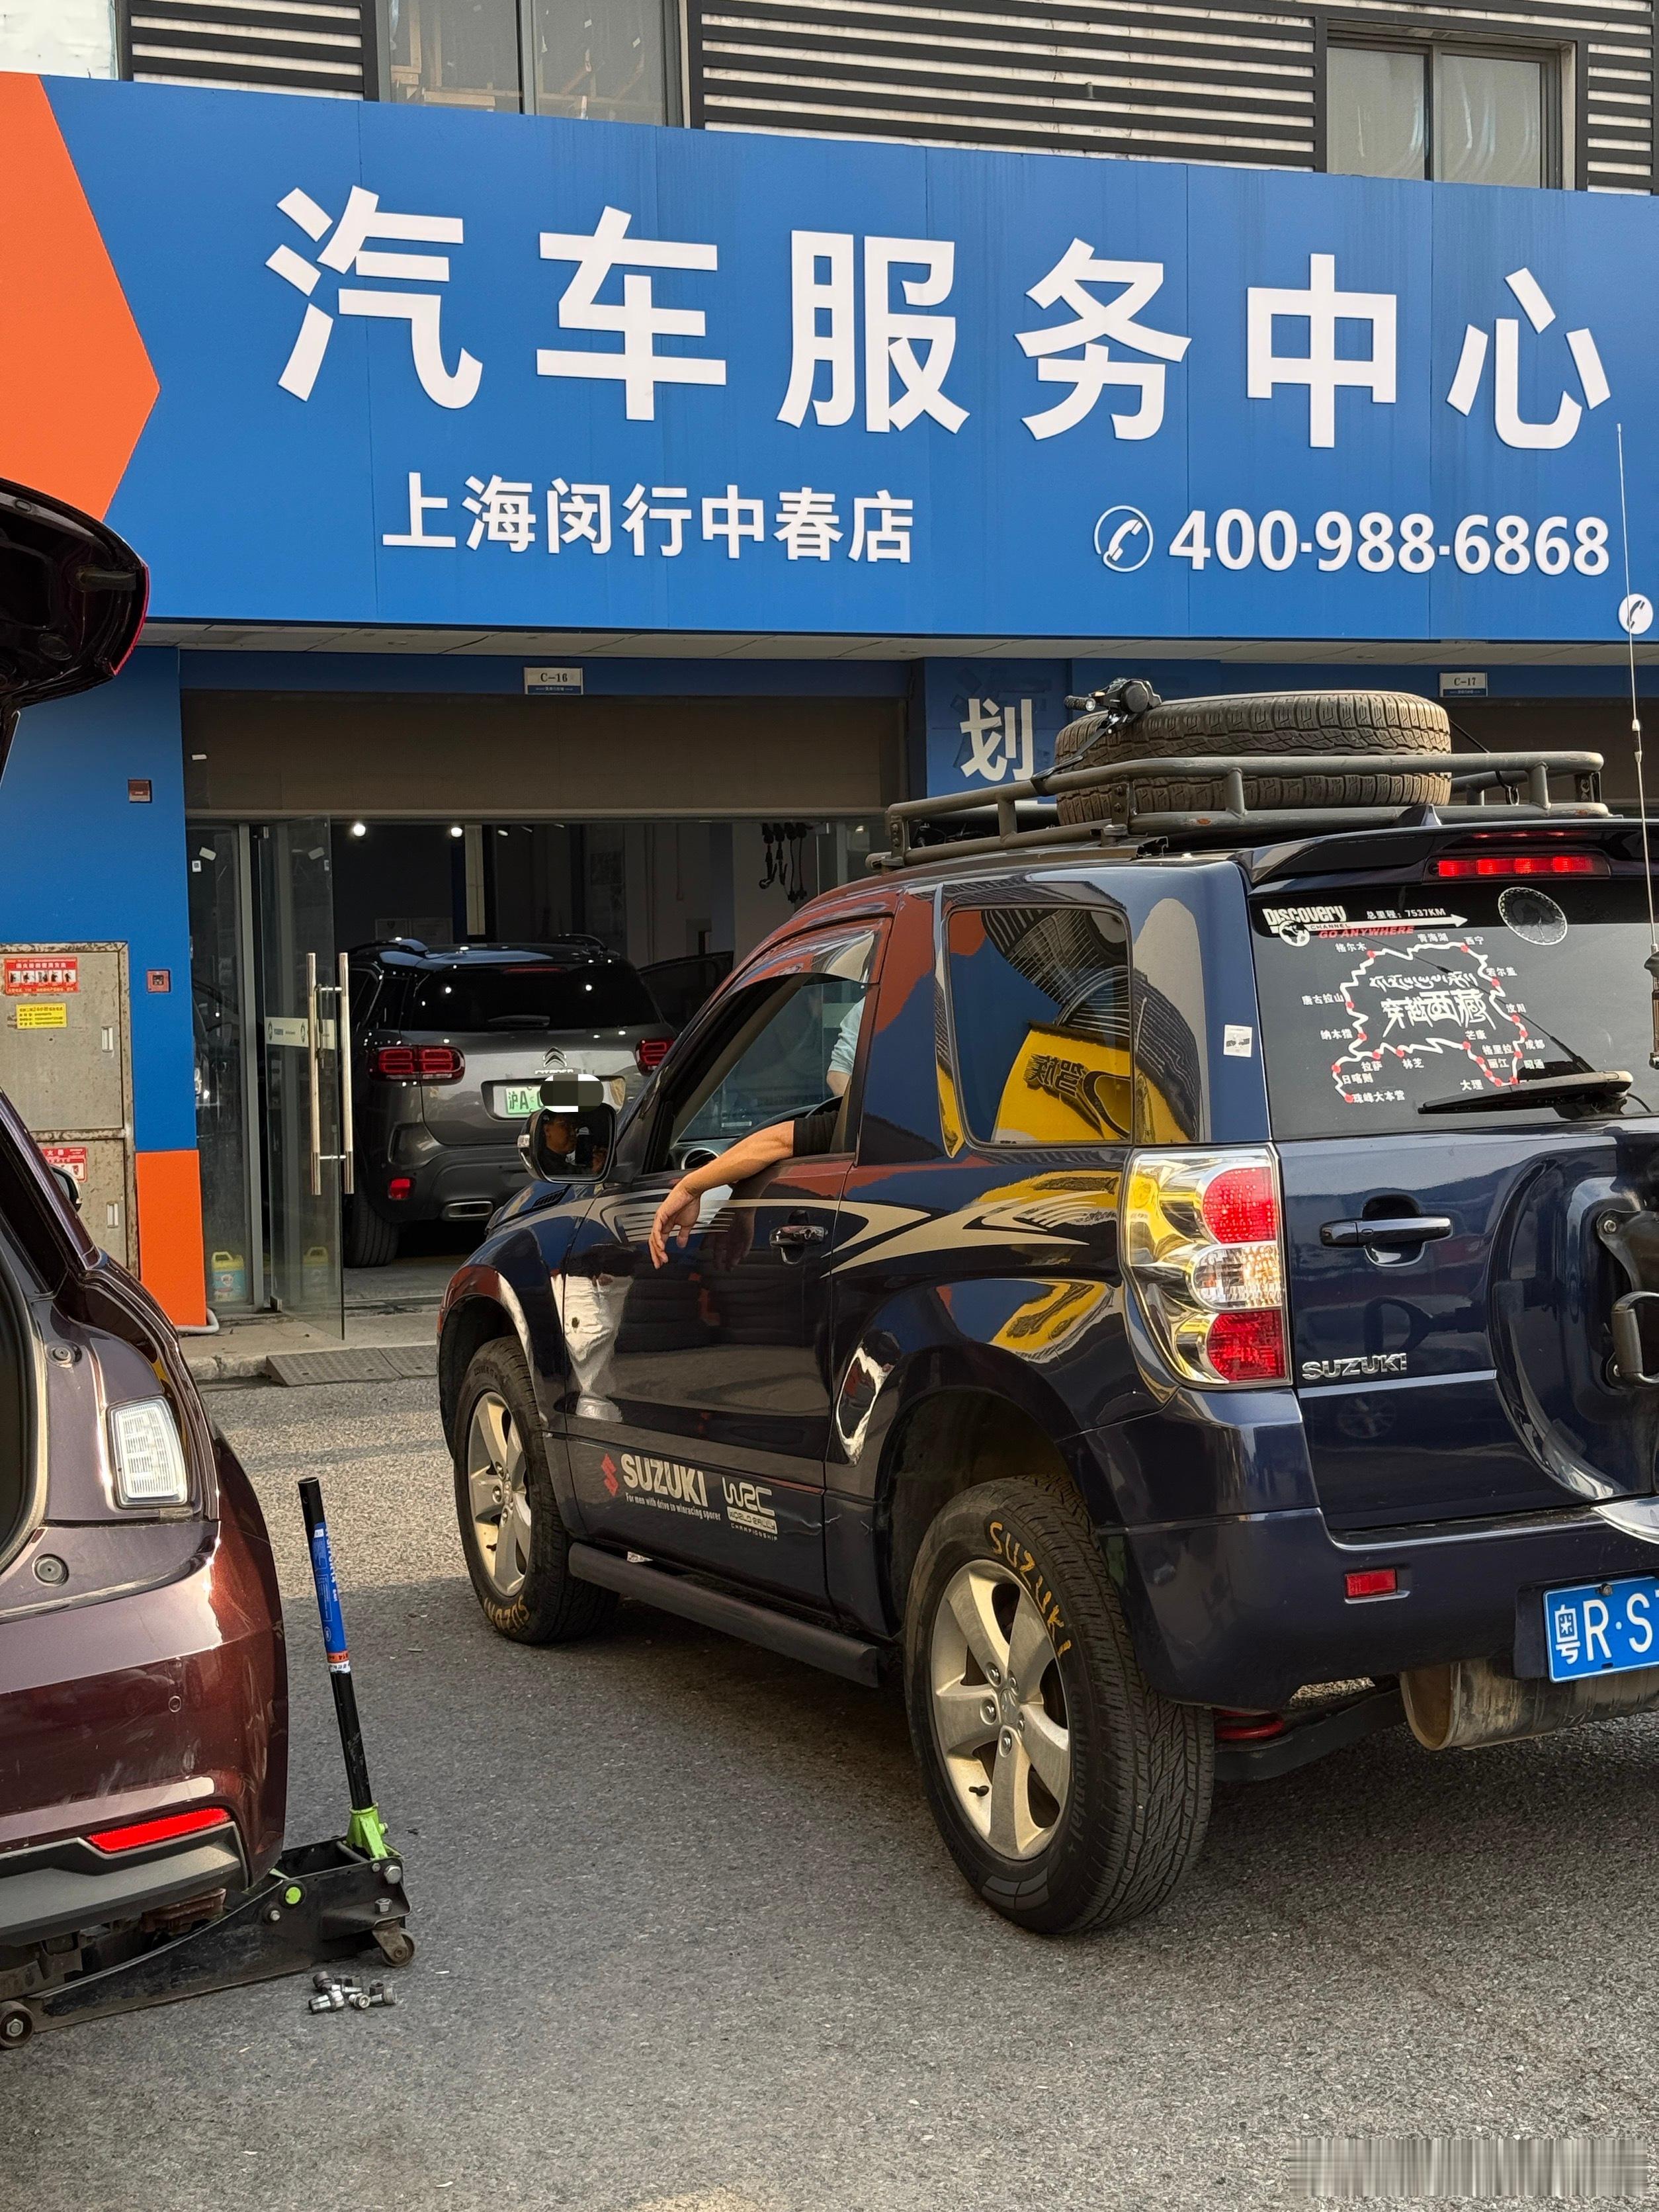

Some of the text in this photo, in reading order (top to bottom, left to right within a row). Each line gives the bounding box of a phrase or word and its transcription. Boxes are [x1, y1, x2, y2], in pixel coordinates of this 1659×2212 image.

[265, 185, 1611, 450] 汽车服务中心
[382, 472, 914, 564] 上海闵行中春店
[540, 673, 568, 683] C-16
[1454, 677, 1476, 686] C-17
[960, 699, 1034, 781] 划
[1404, 908, 1447, 917] 7537KM
[1341, 926, 1416, 937] ANYWHERE
[1417, 933, 1449, 943] 青海湖
[1464, 936, 1484, 945] 西宁
[1335, 943, 1367, 953] 格尔木
[1486, 967, 1517, 977] 若尔盖
[1302, 993, 1345, 1005] 唐古拉山
[1525, 1039, 1546, 1050] 成都
[1361, 1060, 1382, 1072] 拉萨
[1402, 1059, 1424, 1070] 林芝
[1487, 1058, 1510, 1069] 丽江
[1341, 1073, 1373, 1085] 日喀则
[1460, 1080, 1484, 1091] 大理
[1301, 1352, 1408, 1381] SUZUKI
[620, 1453, 708, 1508] SUZUKI
[634, 1495, 646, 1504] men
[645, 1497, 657, 1507] with
[657, 1499, 670, 1511] drive
[1554, 1589, 1659, 1665] 粤R·S
